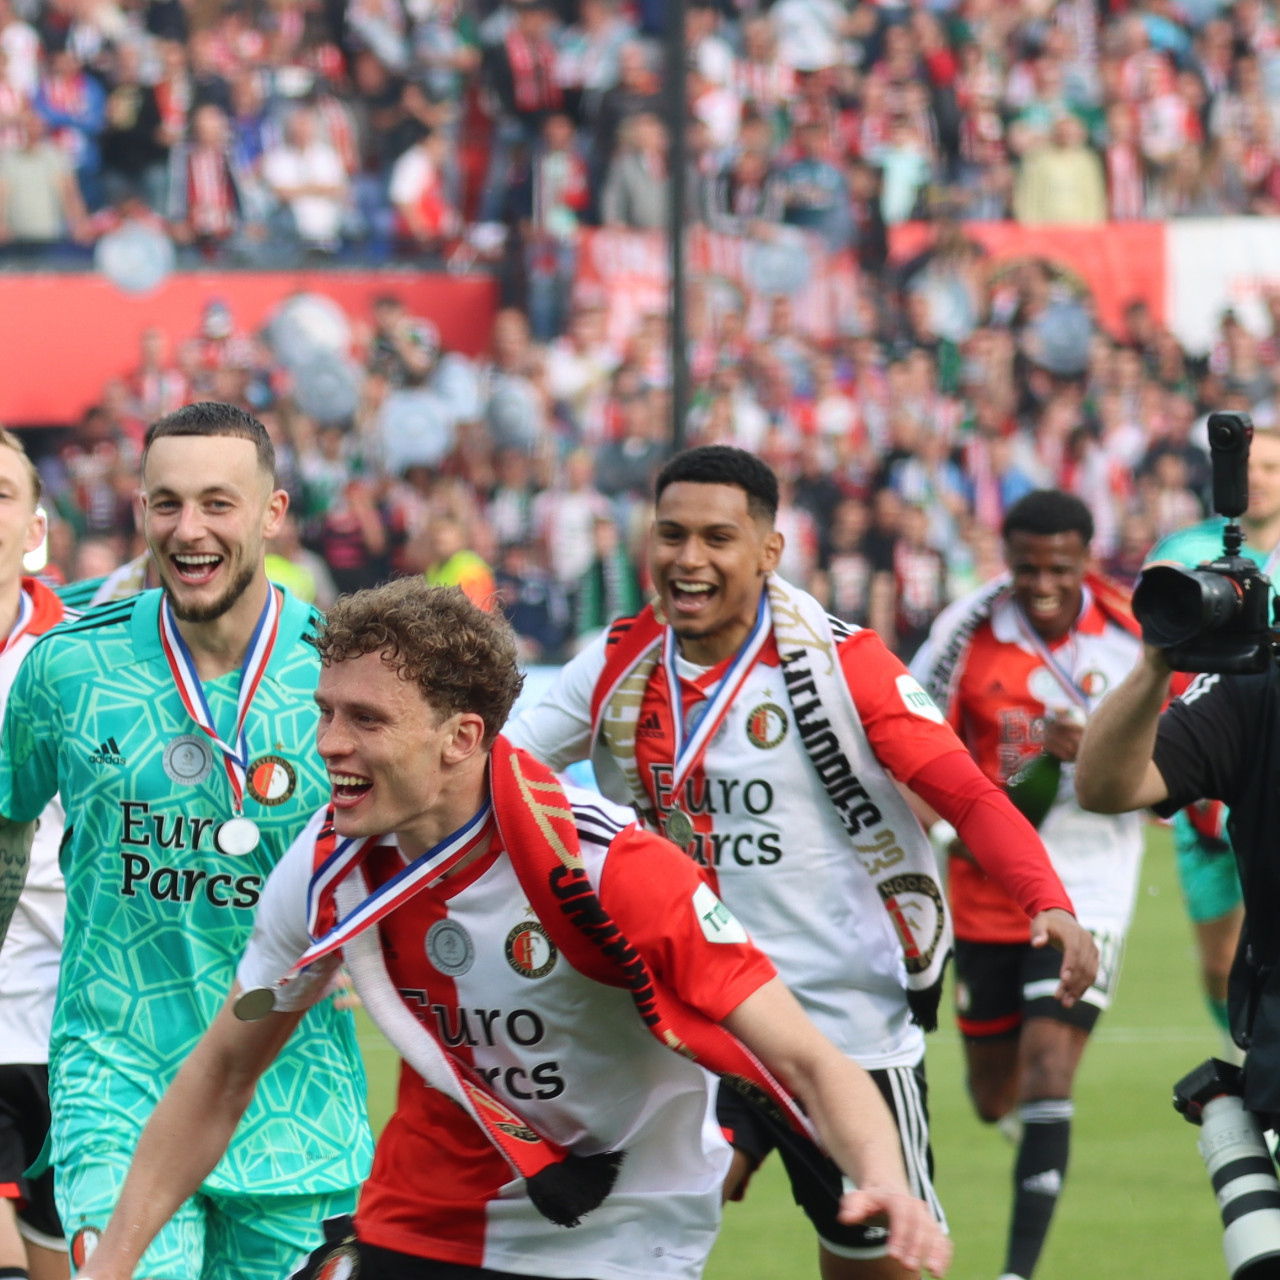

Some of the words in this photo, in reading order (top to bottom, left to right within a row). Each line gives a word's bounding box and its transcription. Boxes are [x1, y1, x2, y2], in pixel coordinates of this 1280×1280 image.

[88, 754, 127, 765] adidas
[119, 800, 227, 856] Eur
[686, 832, 783, 867] arcs
[121, 852, 262, 909] Parcs
